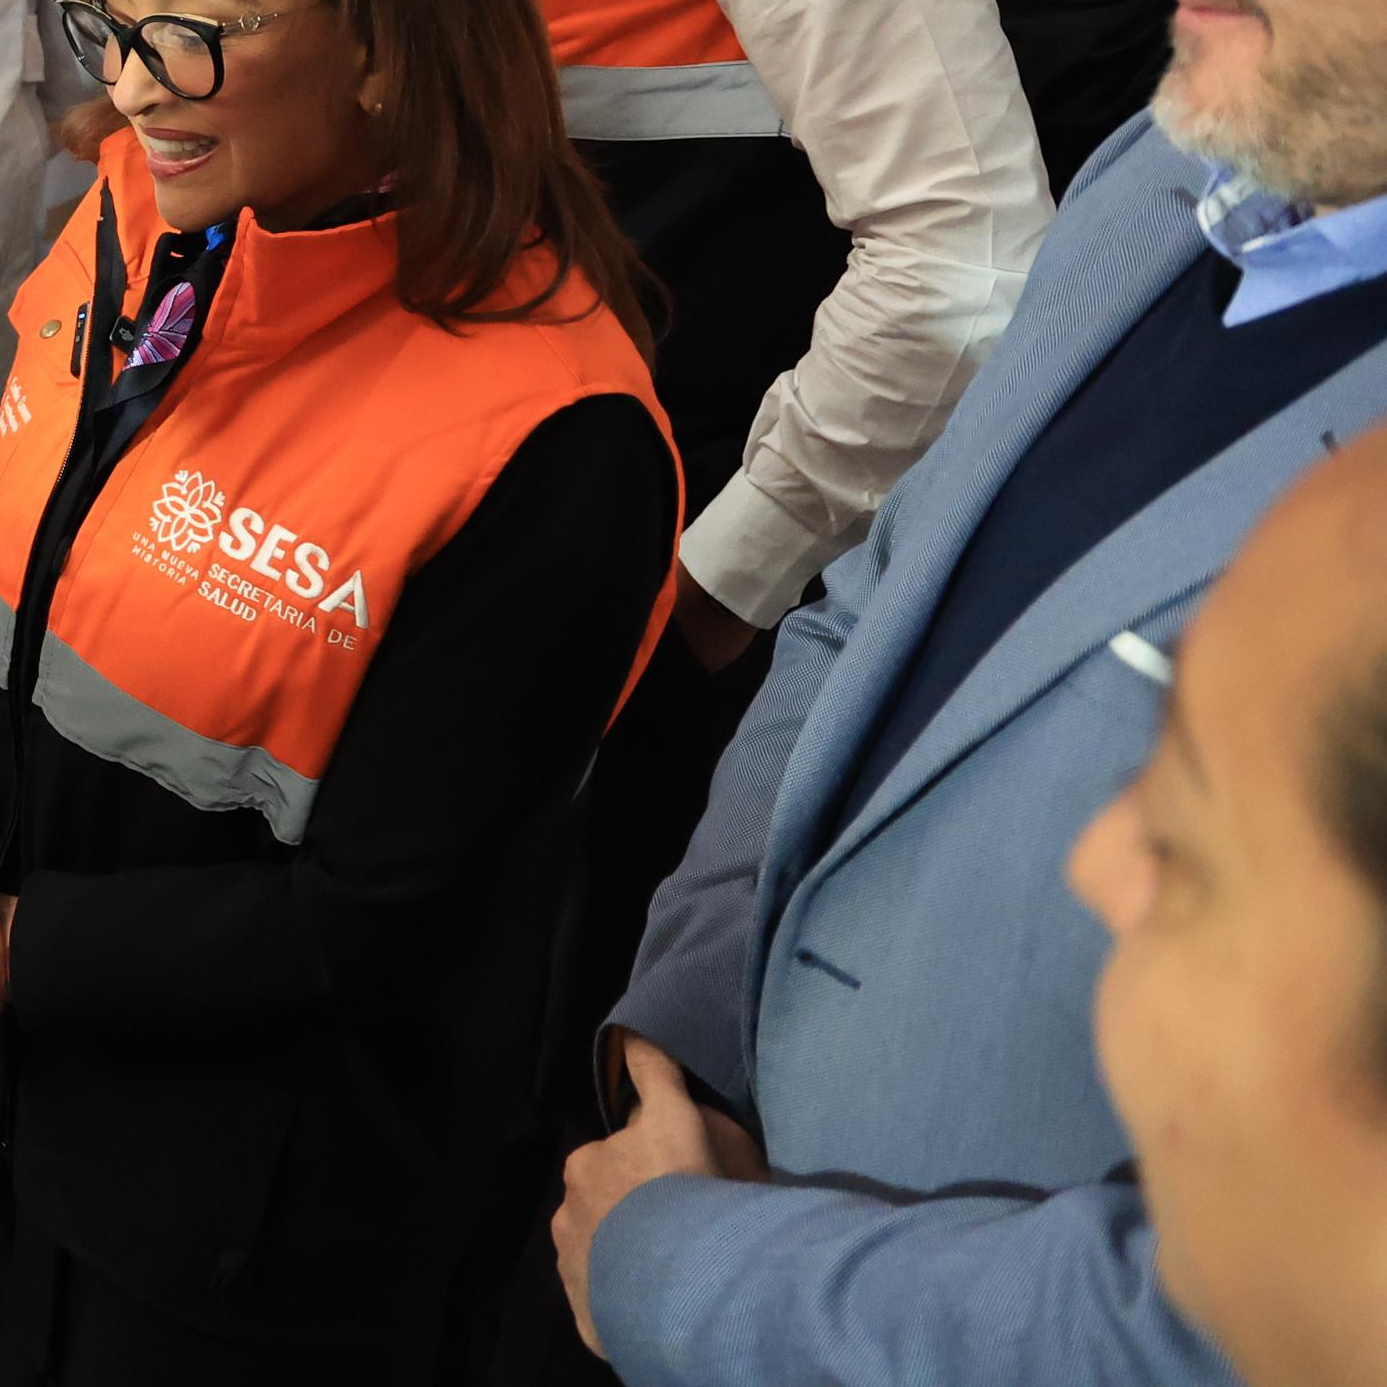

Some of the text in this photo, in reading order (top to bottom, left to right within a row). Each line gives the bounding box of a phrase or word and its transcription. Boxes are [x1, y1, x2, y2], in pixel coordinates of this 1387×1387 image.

[131, 545, 188, 587] HISTORIA
[132, 531, 200, 582] UNA NUEVA
[218, 505, 370, 631] SESA
[197, 580, 259, 623] SALUD
[207, 562, 359, 651] SECRETARIA DE
